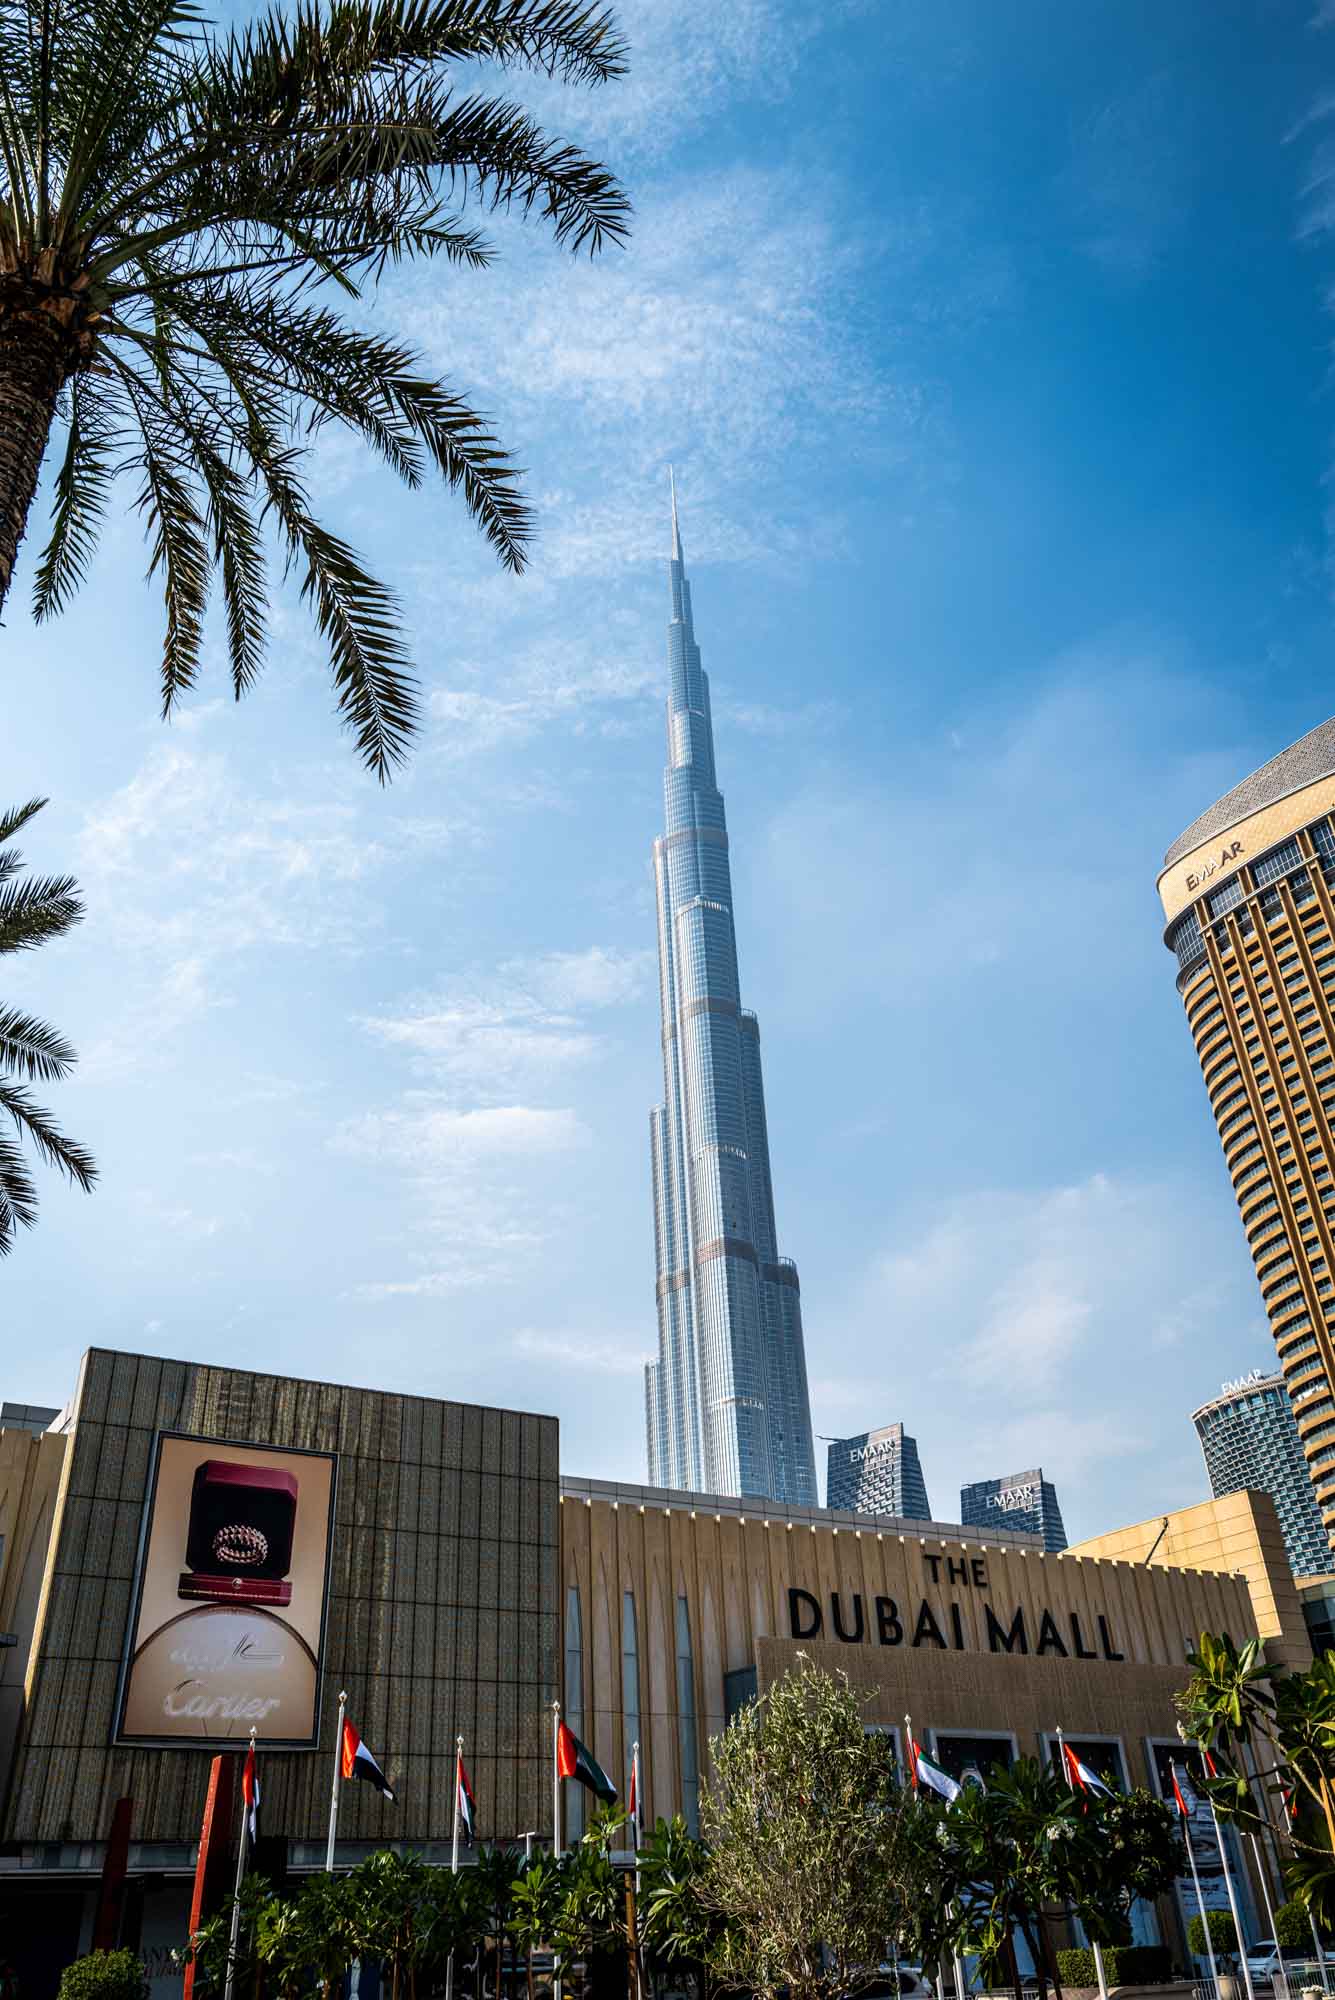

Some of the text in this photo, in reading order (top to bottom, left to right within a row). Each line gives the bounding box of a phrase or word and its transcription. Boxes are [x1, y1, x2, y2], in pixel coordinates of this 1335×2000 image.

[1186, 841, 1245, 892] EMAAR
[850, 1438, 895, 1463] EMAAR
[986, 1484, 1034, 1508] EMAAR
[924, 1554, 988, 1588] THE
[787, 1587, 1125, 1662] DUBAI MALL
